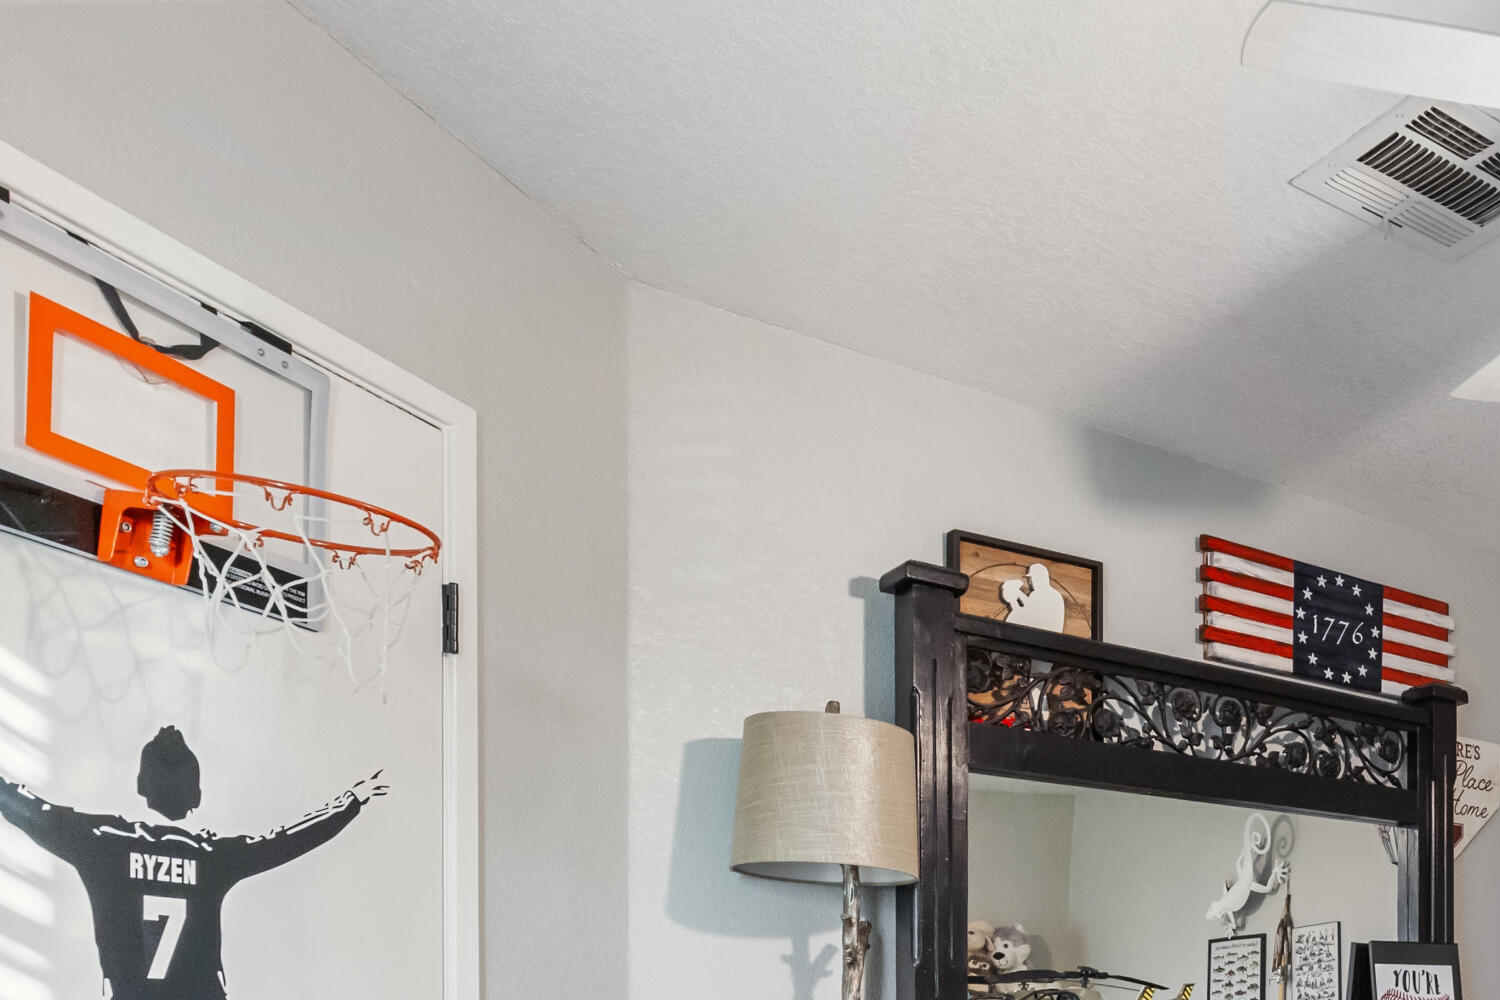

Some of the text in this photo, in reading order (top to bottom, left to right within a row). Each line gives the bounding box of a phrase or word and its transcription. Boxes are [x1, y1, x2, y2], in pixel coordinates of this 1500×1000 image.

[1312, 614, 1364, 645] 1776
[1456, 741, 1481, 760] RE'S
[1456, 759, 1494, 792] Place
[129, 852, 197, 885] RYZEN
[142, 894, 188, 980] 7
[1393, 968, 1442, 995] YOU'RE
